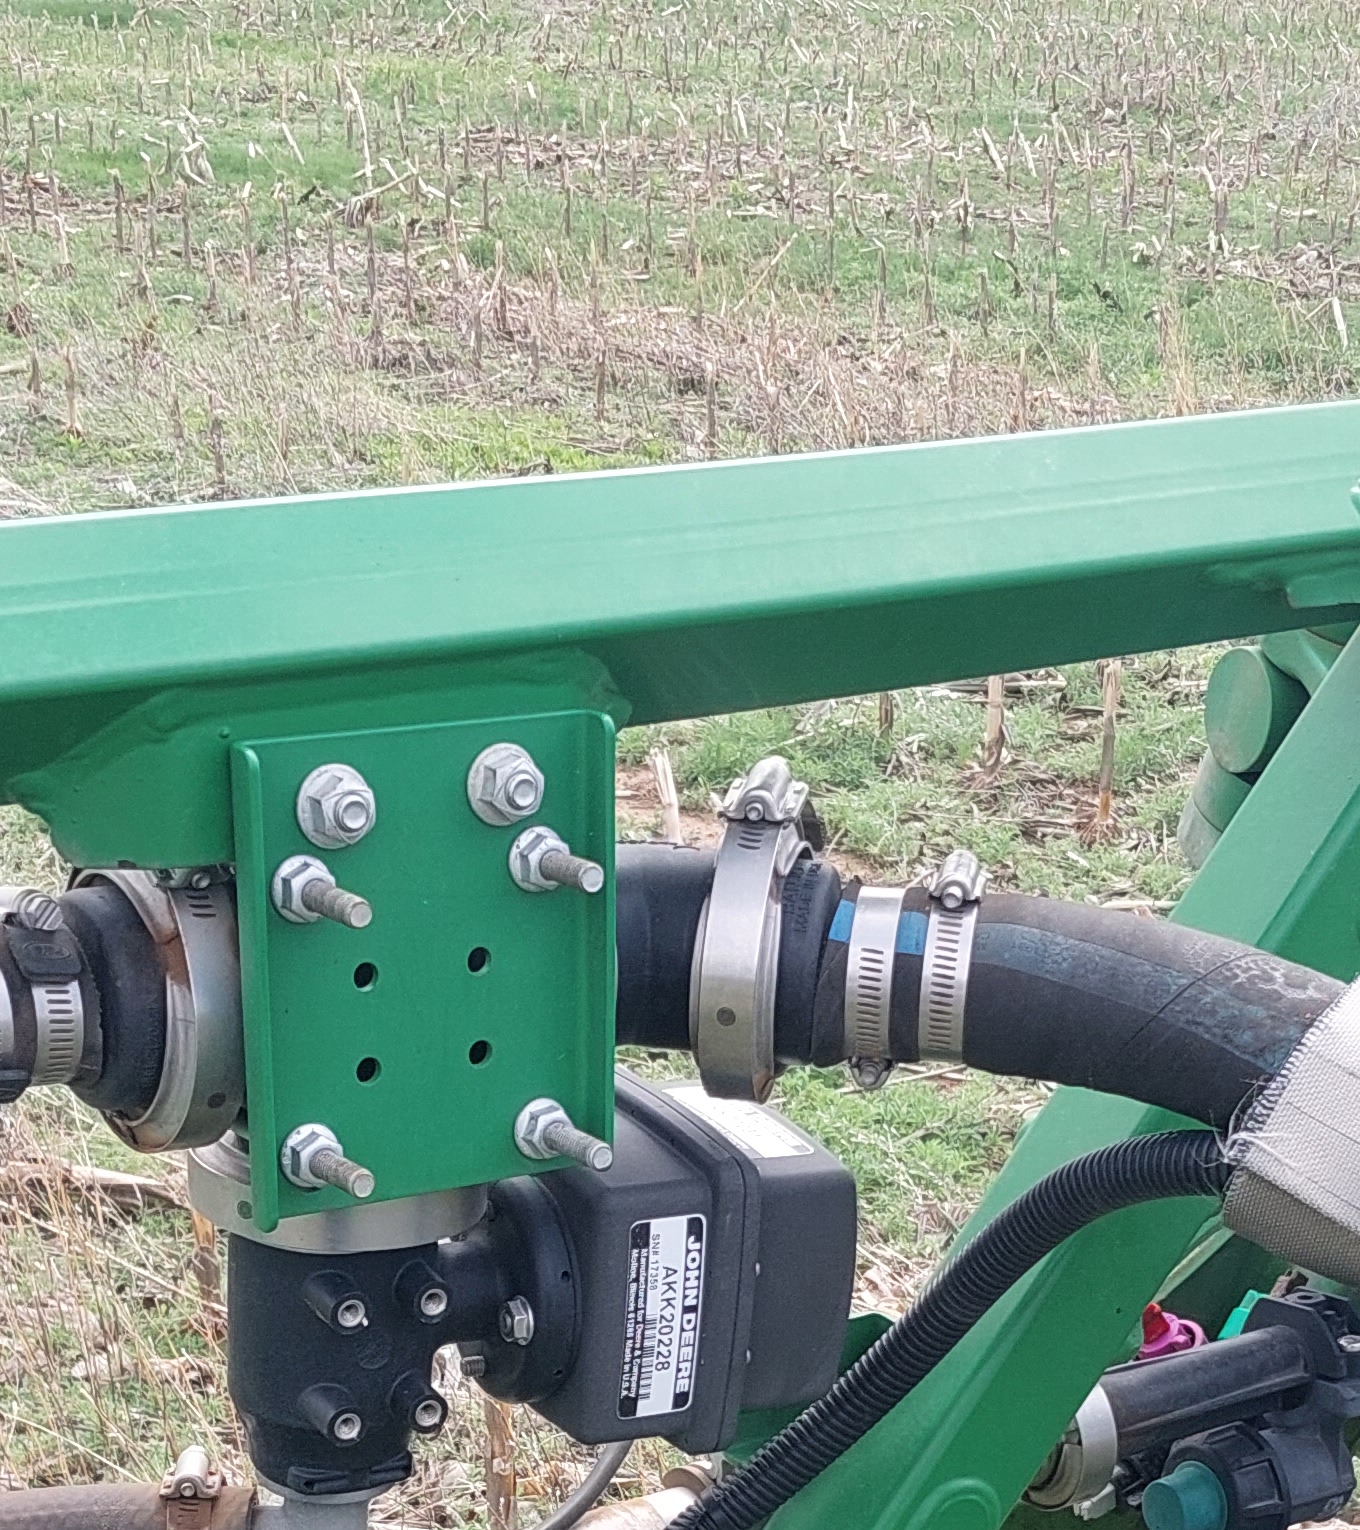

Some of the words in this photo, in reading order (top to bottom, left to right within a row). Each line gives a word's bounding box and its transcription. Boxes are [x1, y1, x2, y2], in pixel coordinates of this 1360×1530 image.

[637, 1248, 649, 1309] Manufactured
[683, 1235, 702, 1307] JOHN
[627, 1282, 638, 1312] Illinois
[636, 1309, 645, 1322] for
[654, 1265, 679, 1372] AKK20228
[623, 1339, 634, 1363] Made
[634, 1323, 644, 1349] Deere
[622, 1363, 632, 1373] in
[633, 1349, 642, 1357] &
[675, 1312, 697, 1394] DEERE
[628, 1358, 641, 1398] Company
